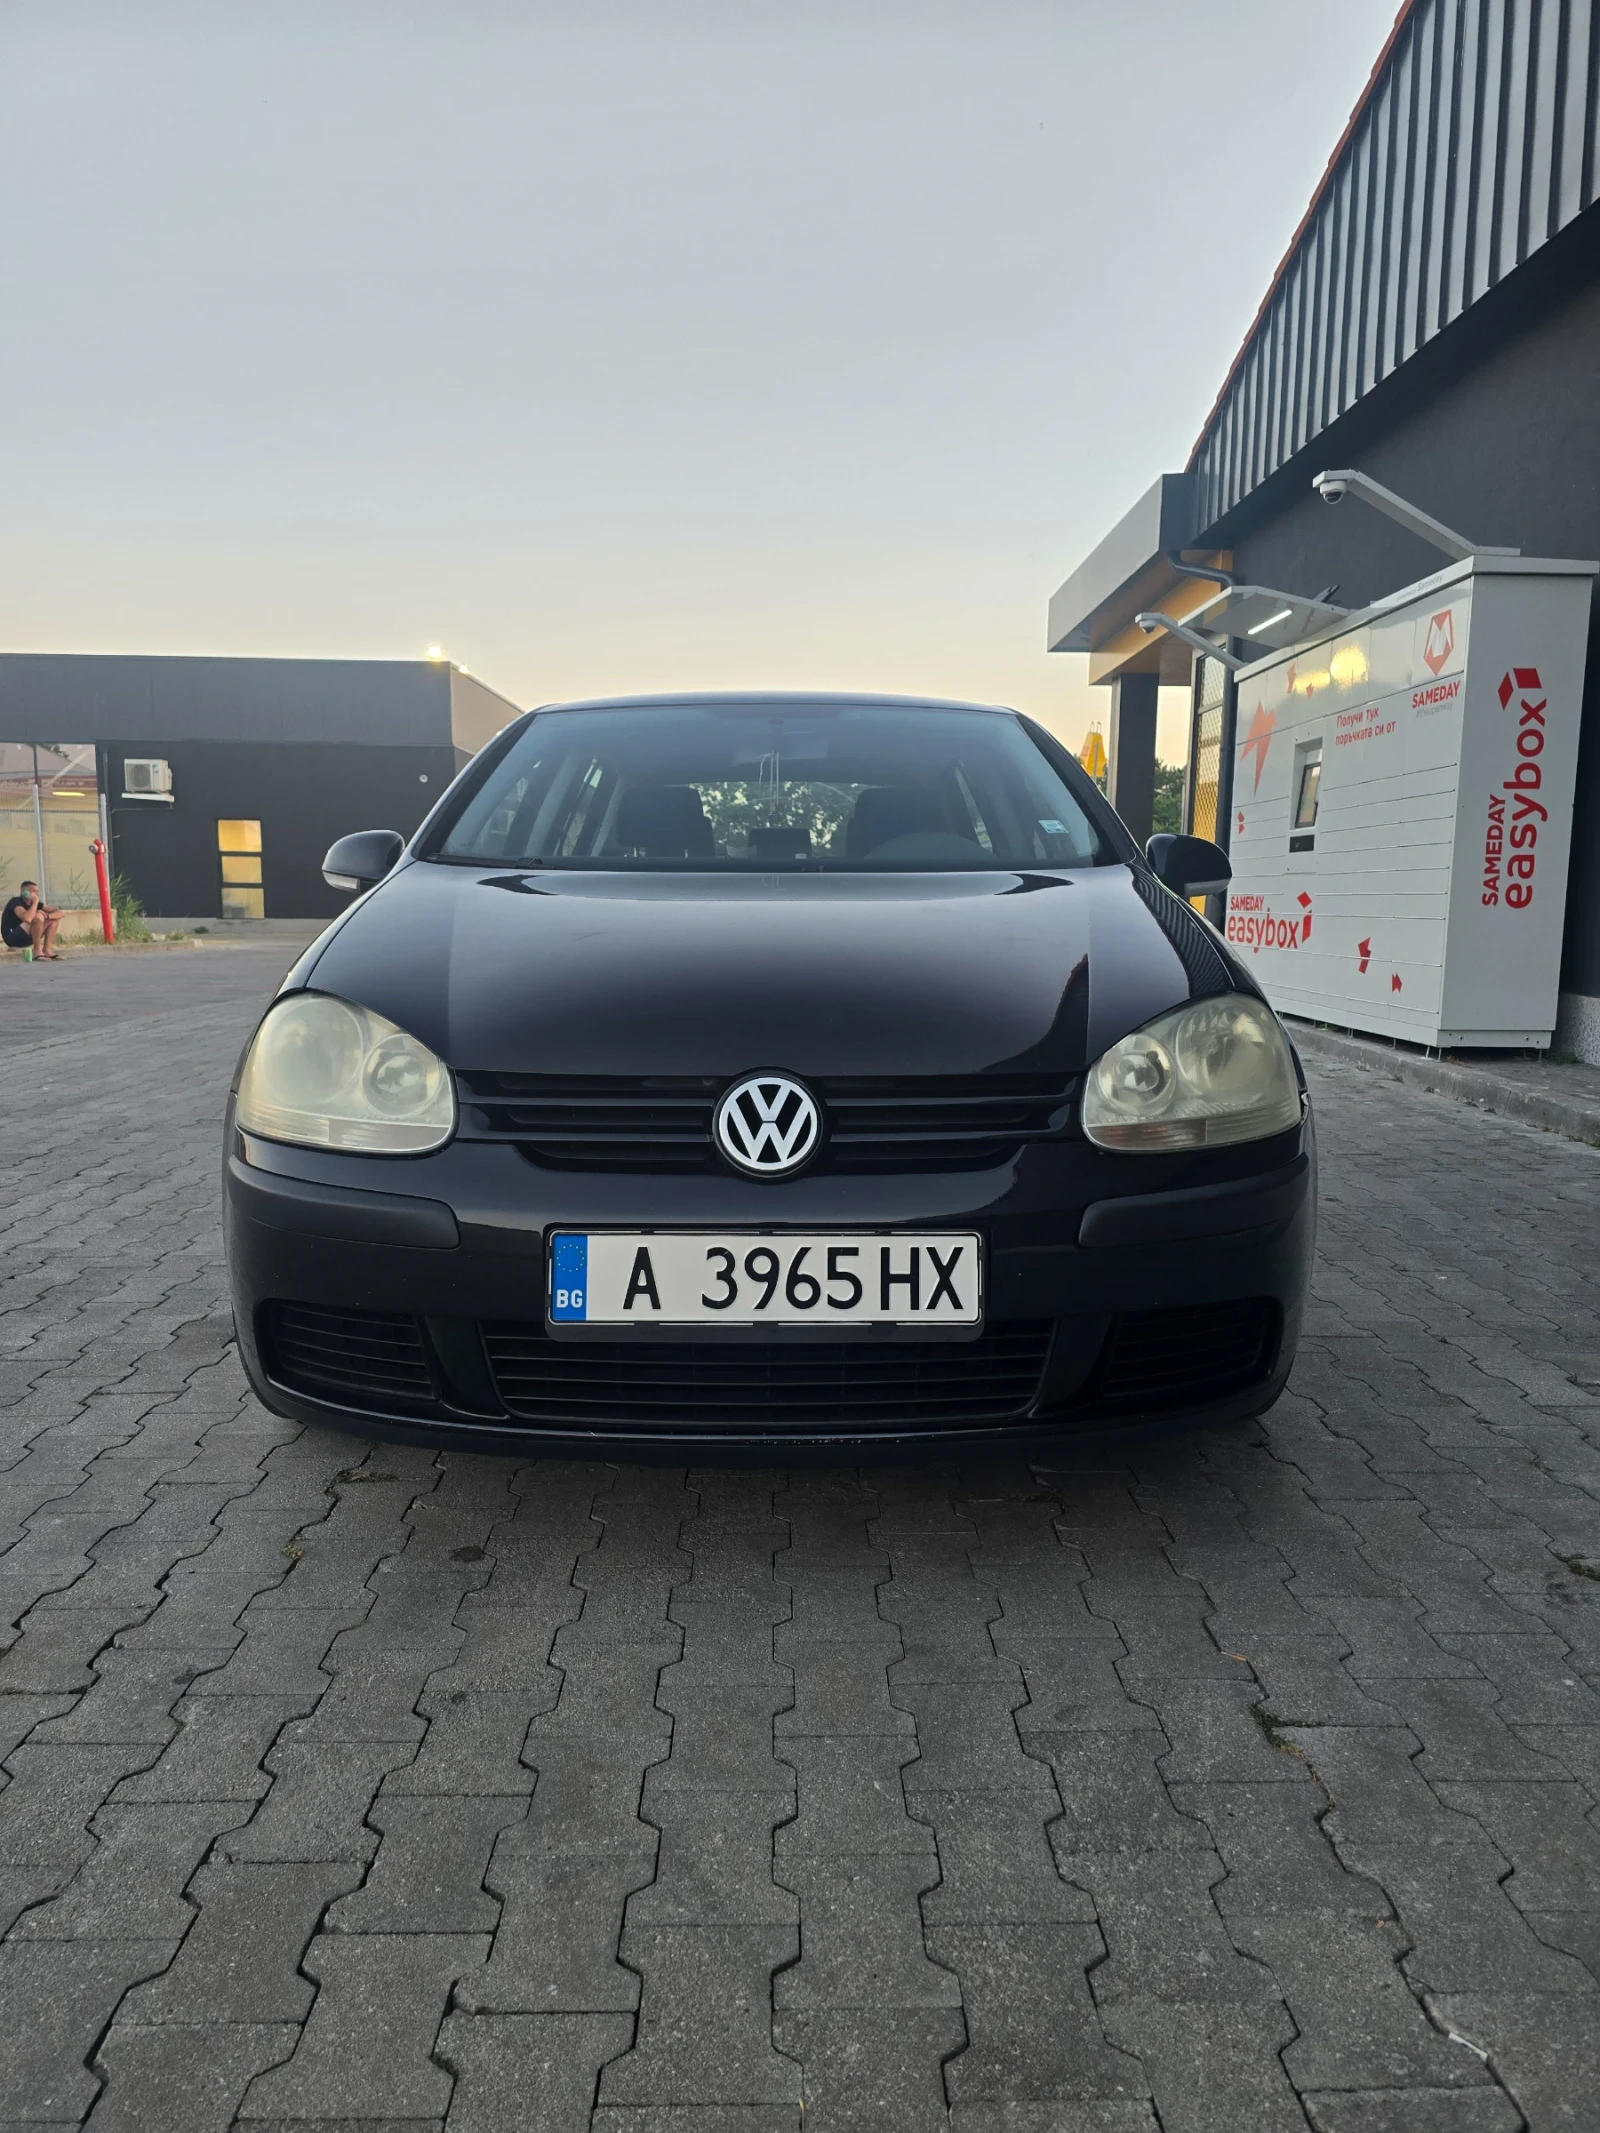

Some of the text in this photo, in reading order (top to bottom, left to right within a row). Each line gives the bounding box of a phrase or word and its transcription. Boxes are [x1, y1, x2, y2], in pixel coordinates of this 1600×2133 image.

[1412, 680, 1461, 709] SAMEDAY
[1336, 707, 1379, 729] Получи тук
[1335, 721, 1396, 746] поръчката си от
[1504, 698, 1548, 909] easybox
[1481, 793, 1505, 907] SAMEDAY
[1230, 895, 1265, 911] SAMEDAY
[1227, 907, 1299, 953] easybox
[622, 1246, 662, 1310] A
[556, 1289, 583, 1308] BG
